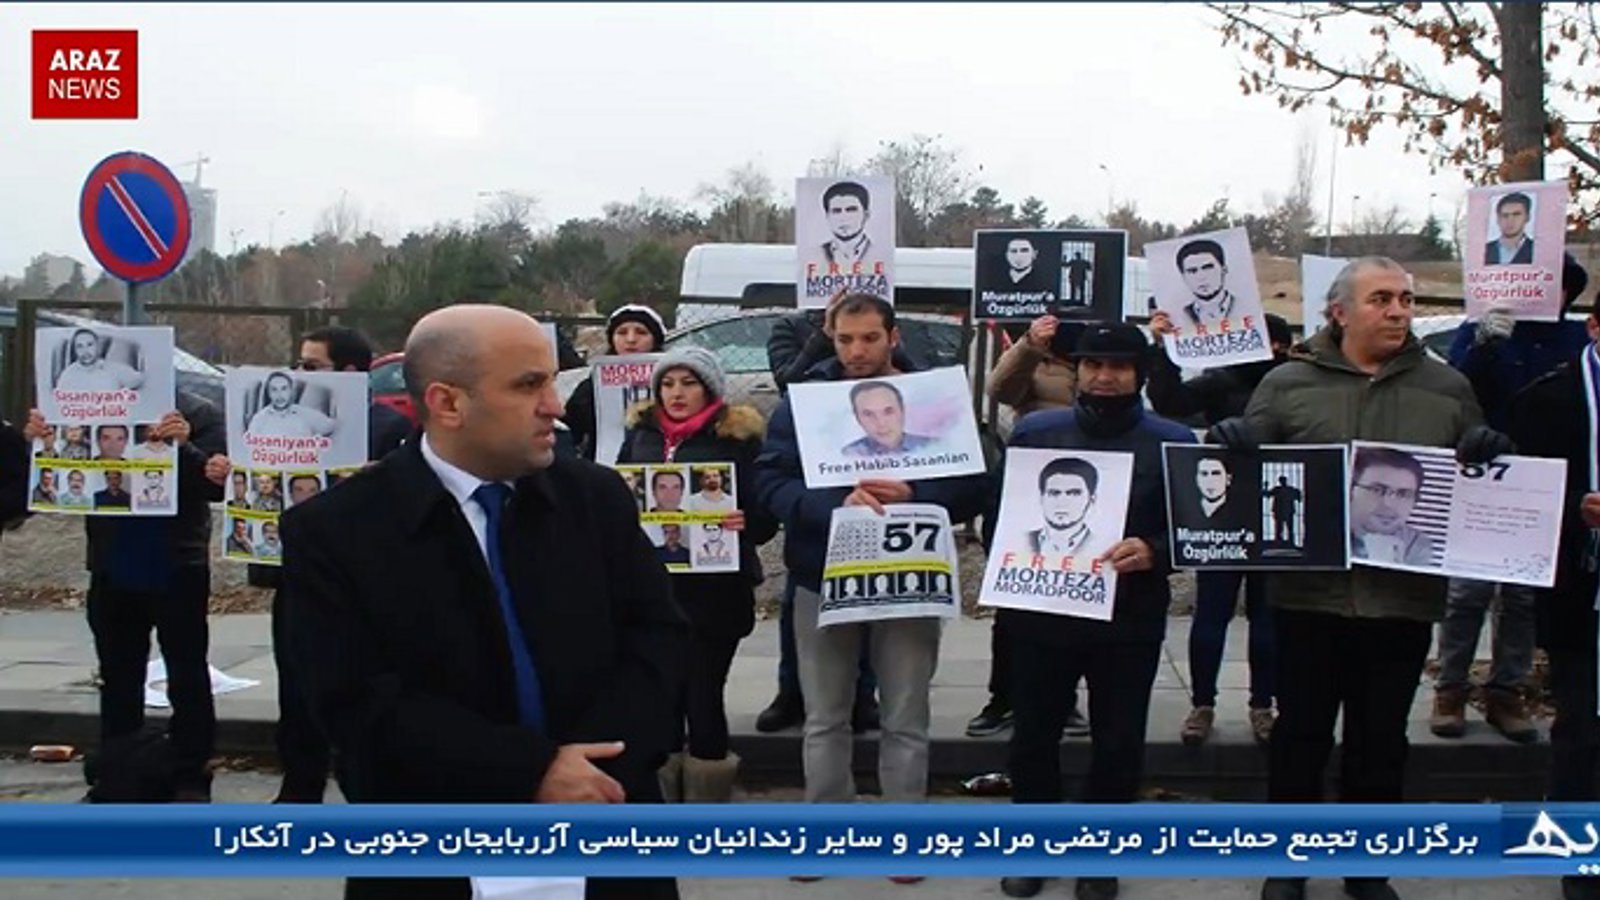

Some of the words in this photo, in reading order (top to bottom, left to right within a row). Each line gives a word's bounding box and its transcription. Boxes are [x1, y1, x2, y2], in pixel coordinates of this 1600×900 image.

[806, 274, 888, 289] MORTEZA
[1468, 269, 1554, 284] Muratpur'a
[982, 290, 1055, 305] Muratpur'a
[986, 302, 1049, 317] Özgürlük
[1176, 328, 1262, 350] MORTEZA
[54, 389, 137, 405] Sasaniyan'a
[60, 404, 127, 420] Özgürlük
[245, 434, 329, 450] Sasaniyan'a
[252, 449, 319, 465] Özgürlük
[818, 462, 852, 475] Free
[855, 458, 901, 471] Habib
[903, 452, 970, 468] Sasanian
[882, 523, 942, 552] 57
[1176, 527, 1255, 545] Muratpur'a
[1182, 543, 1249, 561] Özgürlük
[1002, 552, 1104, 574] FREE
[997, 567, 1106, 592] MORTEZA
[993, 581, 1106, 605] MORADPOOR
